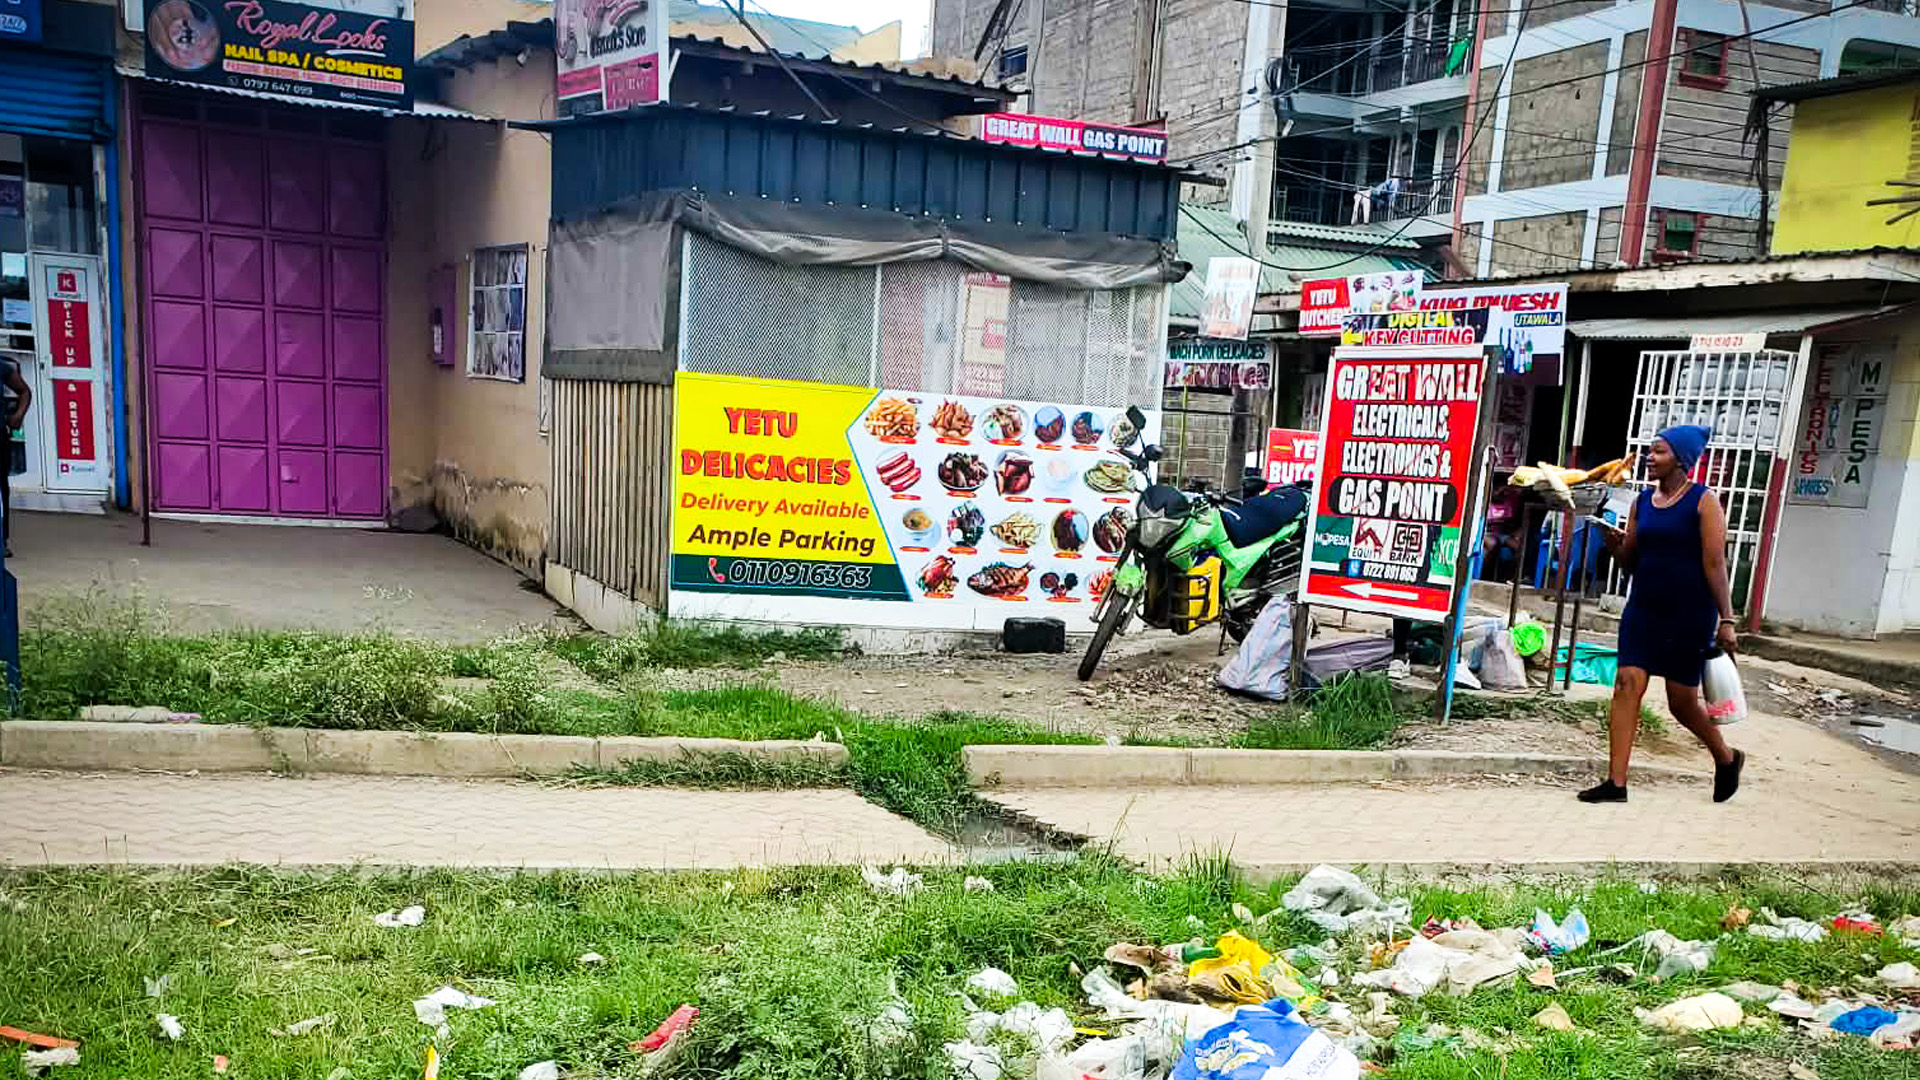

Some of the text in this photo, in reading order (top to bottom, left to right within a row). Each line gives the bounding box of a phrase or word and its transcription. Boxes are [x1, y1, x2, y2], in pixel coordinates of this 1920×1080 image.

[224, 0, 389, 50] Royal Looks
[224, 44, 264, 61] NAIL
[267, 50, 300, 67] SPA
[313, 57, 403, 80] COSMETICS
[986, 117, 1165, 156] GREAT WALL GAS POINT
[1310, 288, 1336, 305] YETU
[1399, 327, 1474, 345] CUTTING
[1514, 313, 1562, 327] UTAWALA
[1336, 364, 1479, 401] GREAT WALL
[724, 407, 798, 438] YETU
[1844, 361, 1882, 484] M-PESA
[681, 449, 852, 486] DELICACIES
[1342, 441, 1452, 478] ELECTRONICS &
[681, 492, 870, 519] Delivery Available
[1338, 478, 1449, 521] GAS POINT
[687, 524, 876, 557] Ample Parking
[729, 560, 873, 589] 0110916363
[1390, 552, 1419, 564] BANK
